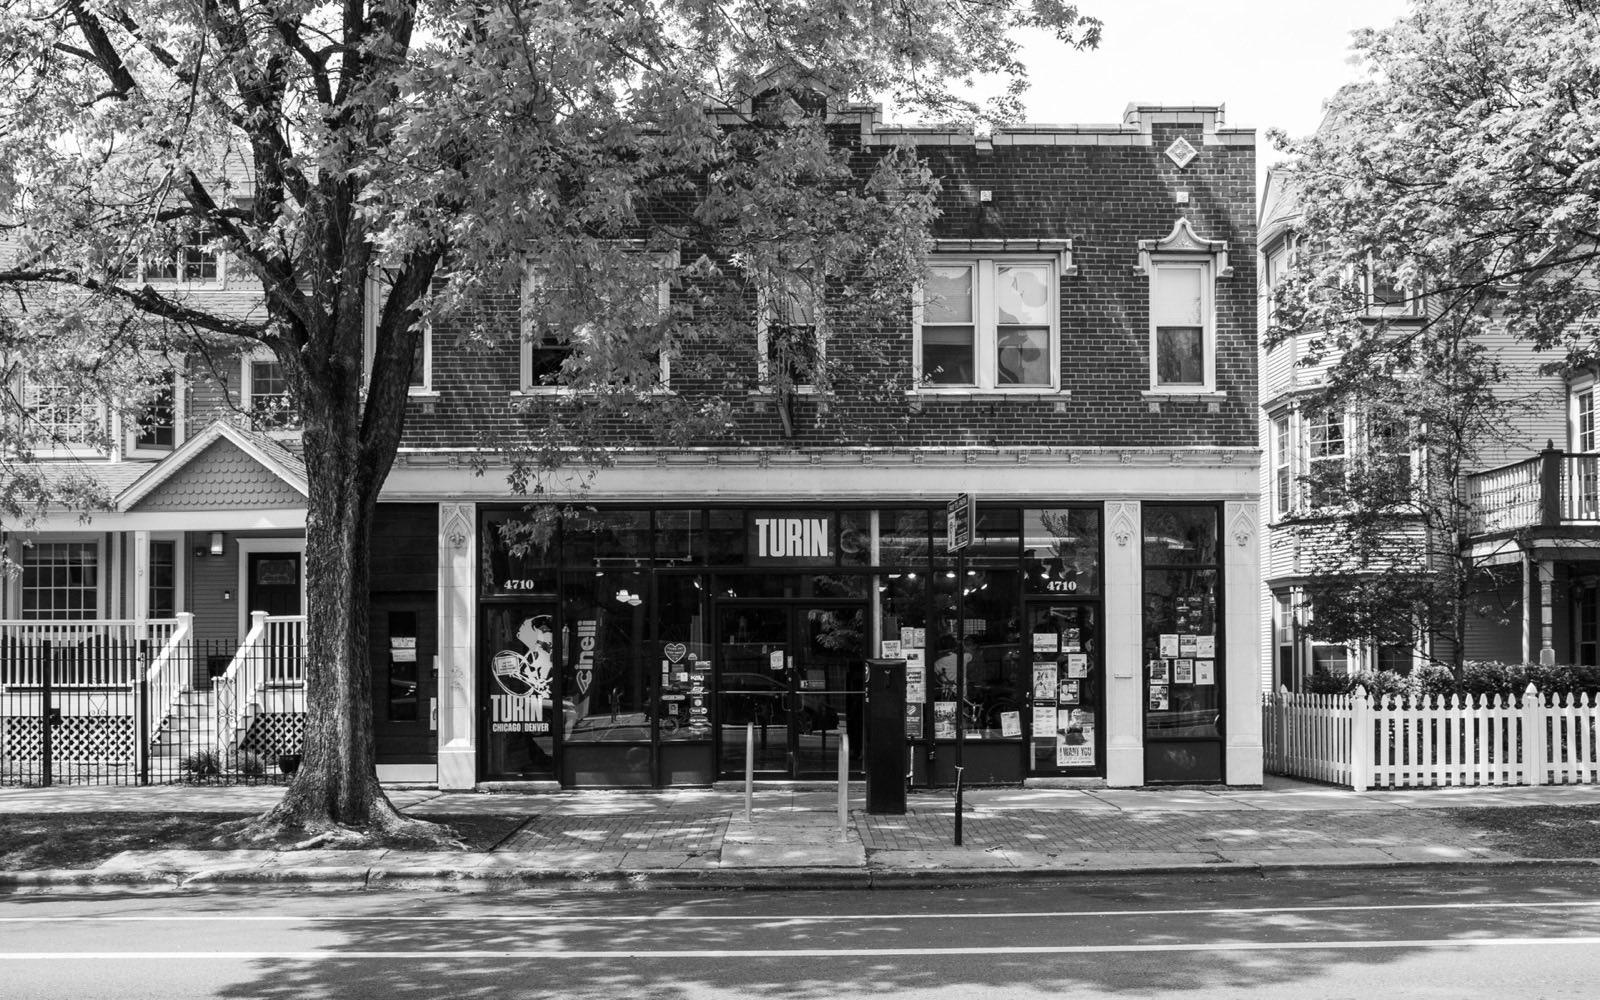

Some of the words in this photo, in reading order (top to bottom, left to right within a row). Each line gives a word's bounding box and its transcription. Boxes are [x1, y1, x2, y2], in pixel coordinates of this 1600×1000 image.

[503, 579, 534, 590] 4710
[1046, 581, 1077, 591] 4710
[490, 694, 543, 722] TURIN
[492, 723, 521, 732] CHICAGO
[524, 723, 550, 732] DENVER
